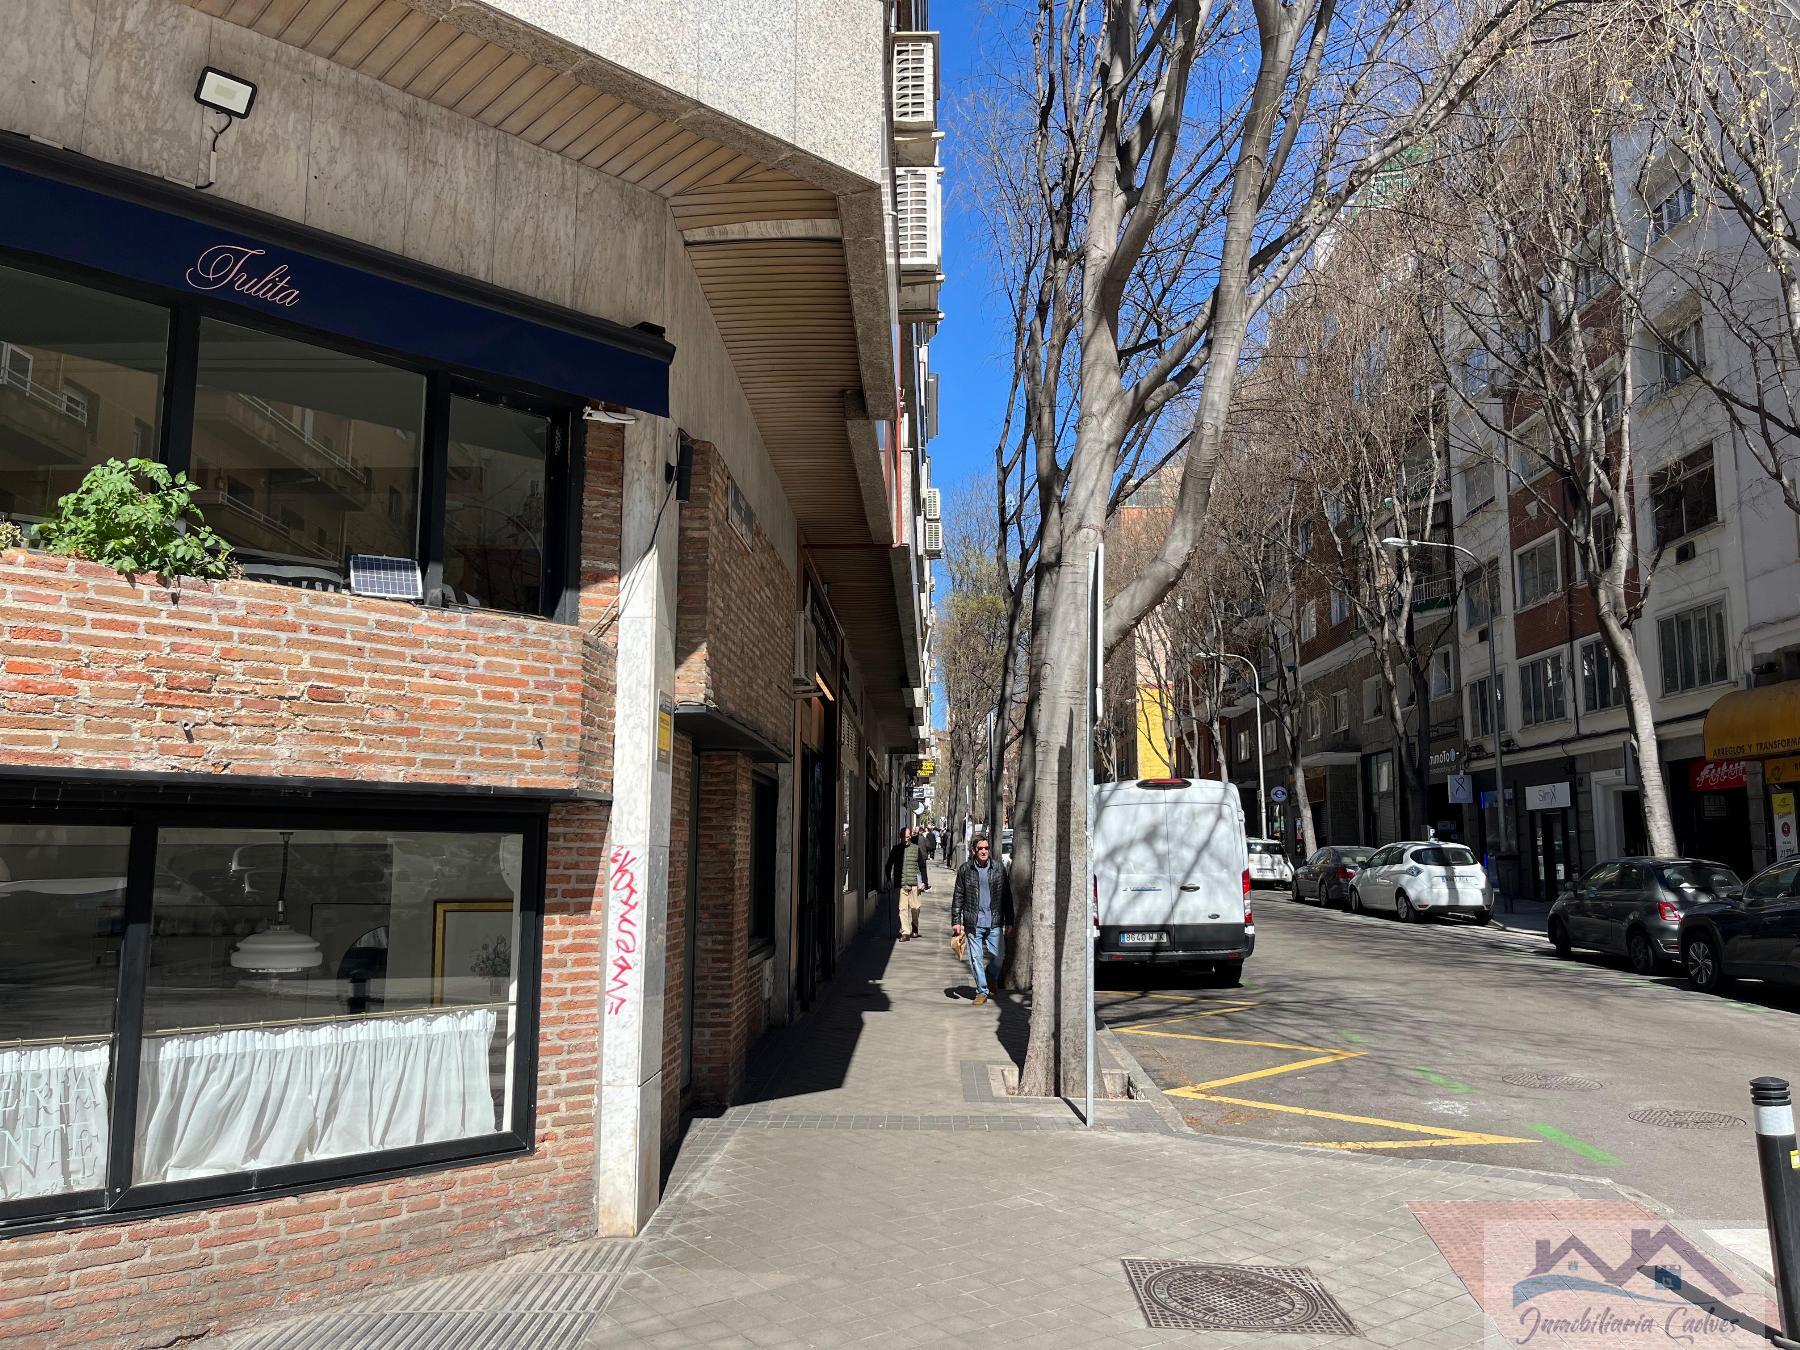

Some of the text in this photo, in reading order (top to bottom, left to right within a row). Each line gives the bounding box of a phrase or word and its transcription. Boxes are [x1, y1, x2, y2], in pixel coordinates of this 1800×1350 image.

[185, 244, 300, 306] Tulita
[1712, 744, 1745, 757] ARREGLOS
[1748, 743, 1753, 753] Y
